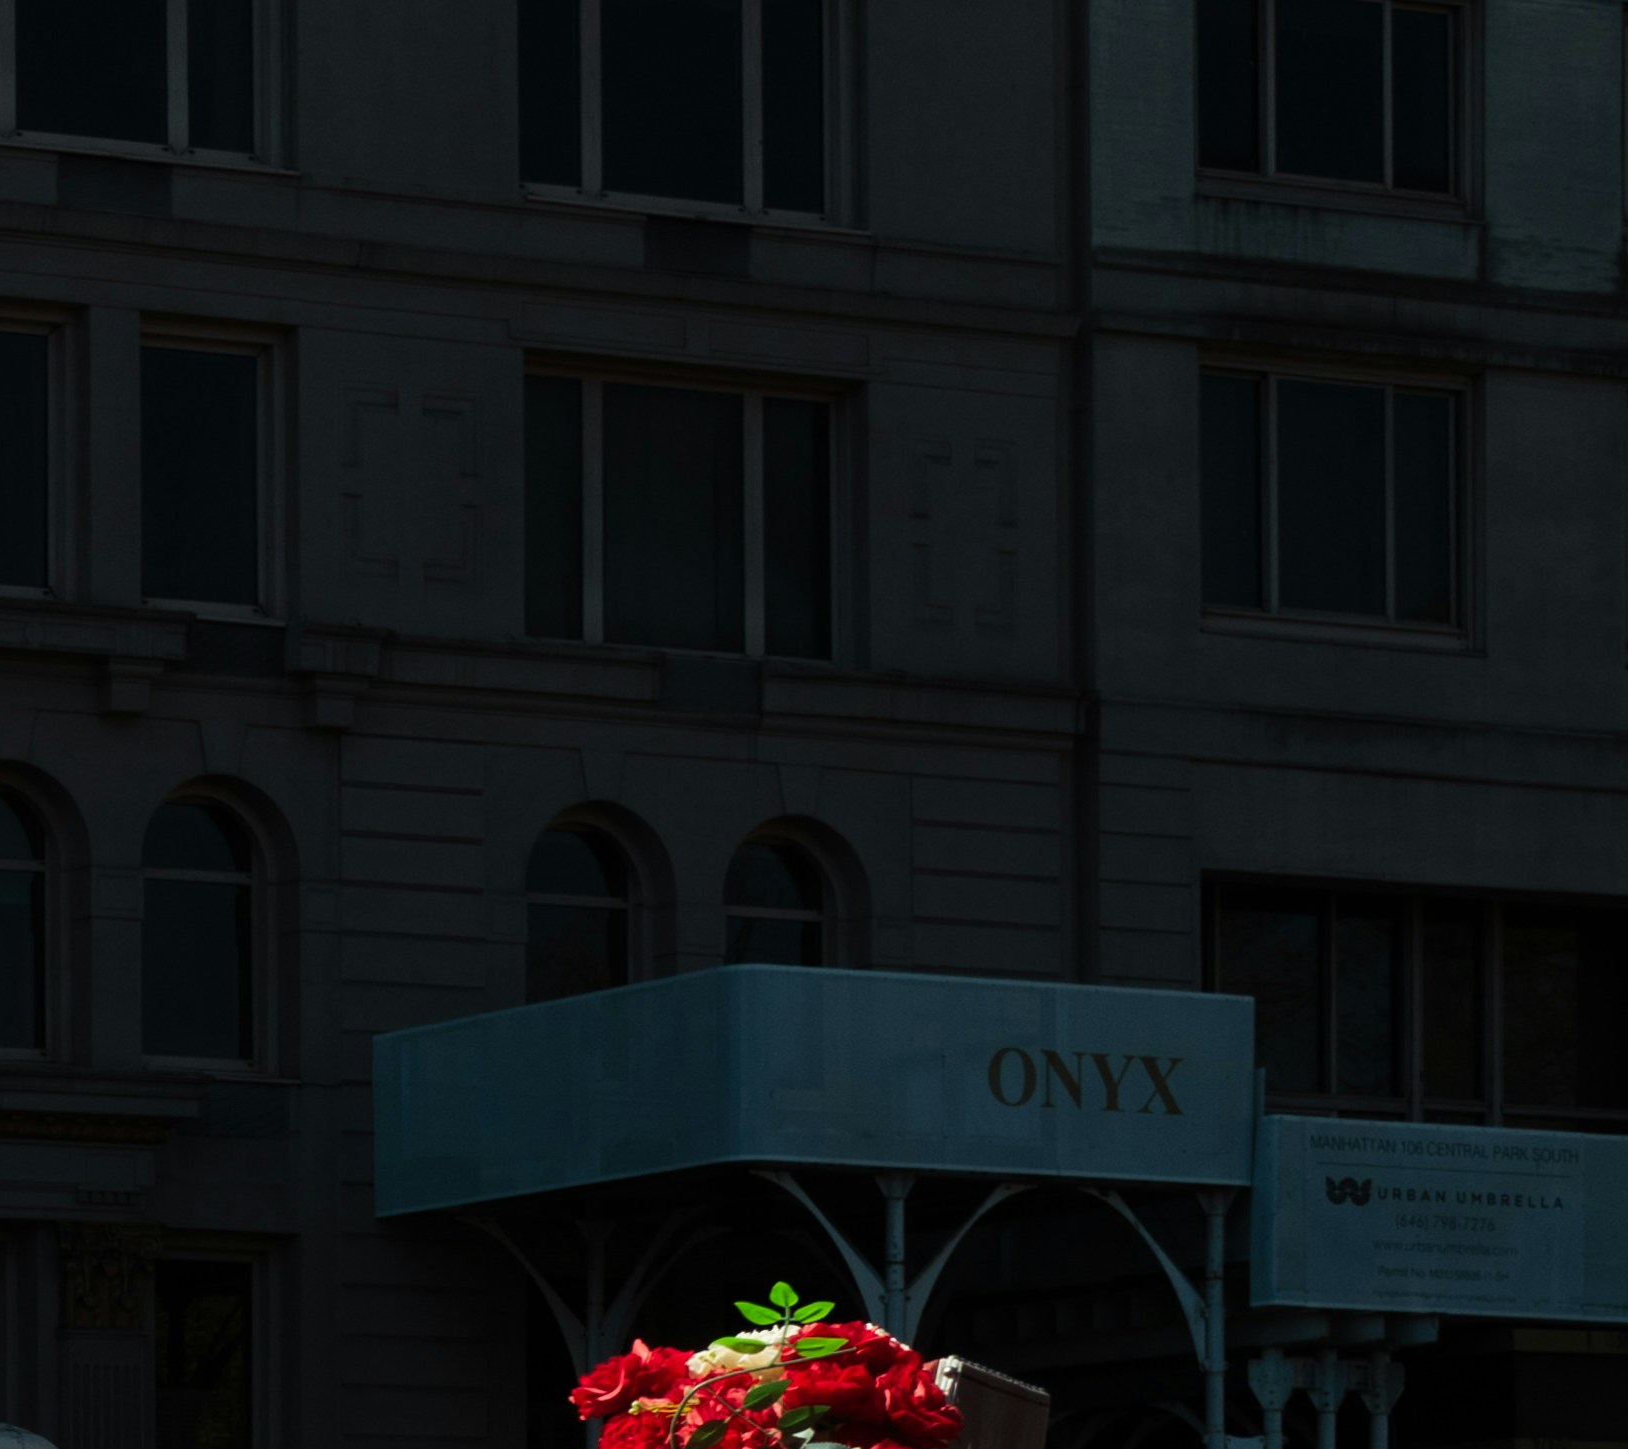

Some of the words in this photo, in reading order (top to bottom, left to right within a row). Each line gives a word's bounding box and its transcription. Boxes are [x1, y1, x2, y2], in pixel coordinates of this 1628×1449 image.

[988, 1047, 1184, 1115] ONYX
[1310, 1135, 1396, 1154] MANHATTAN
[1401, 1141, 1424, 1156] 106
[1427, 1142, 1488, 1159] CENTRAL
[1492, 1146, 1529, 1162] PARK
[1532, 1147, 1579, 1165] SOUTH
[1377, 1186, 1447, 1203] URBAN
[1456, 1191, 1564, 1209] UMBRELLA
